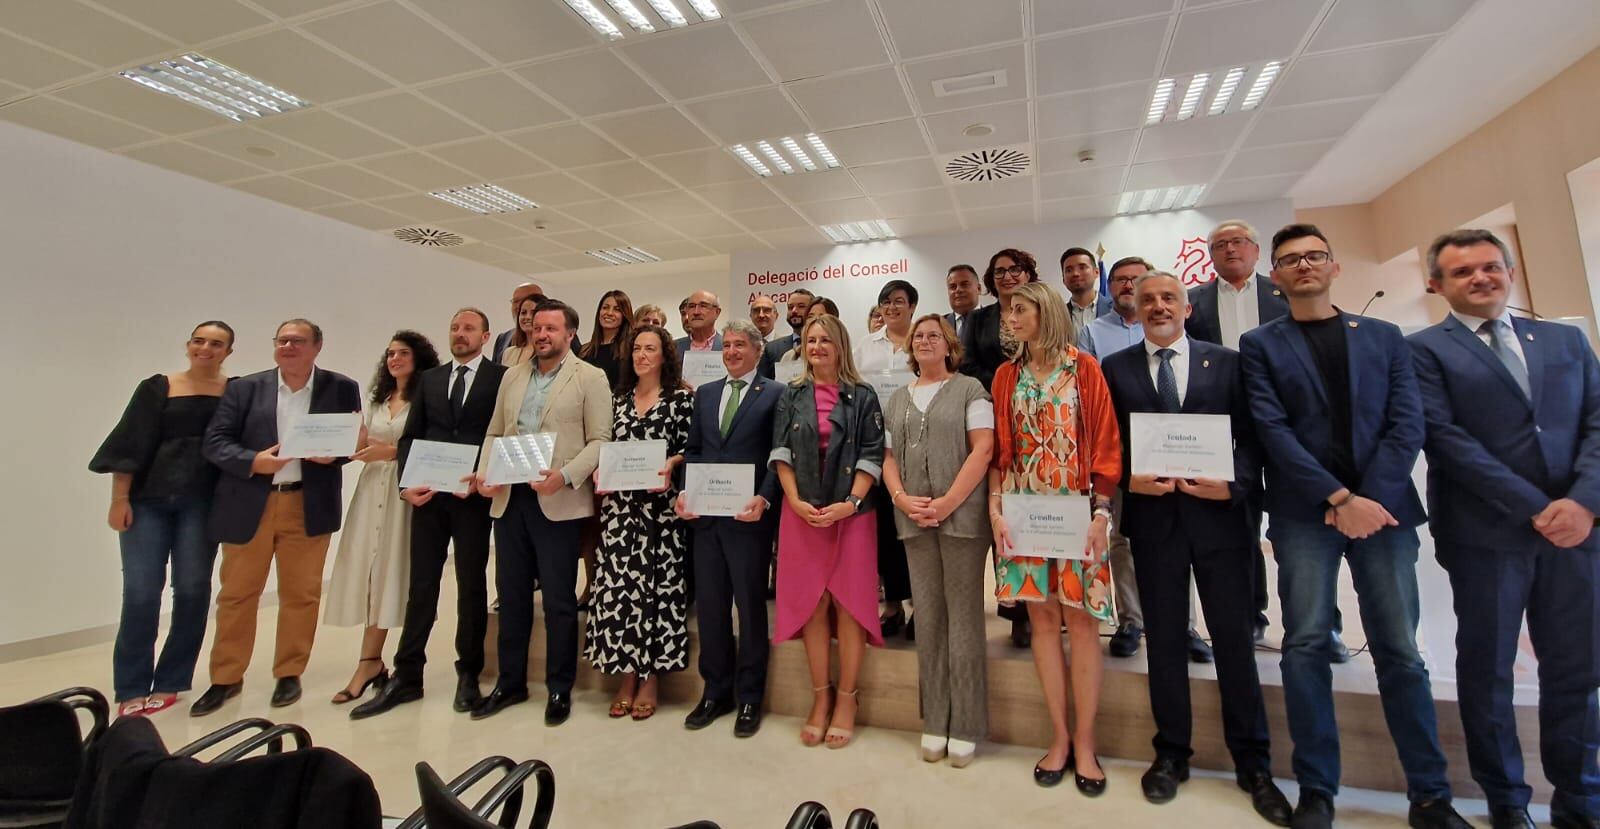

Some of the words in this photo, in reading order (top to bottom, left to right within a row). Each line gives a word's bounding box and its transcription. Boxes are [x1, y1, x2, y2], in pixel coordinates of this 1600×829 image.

[748, 266, 818, 286] Delegació
[823, 264, 845, 279] del
[850, 258, 908, 278] Consell
